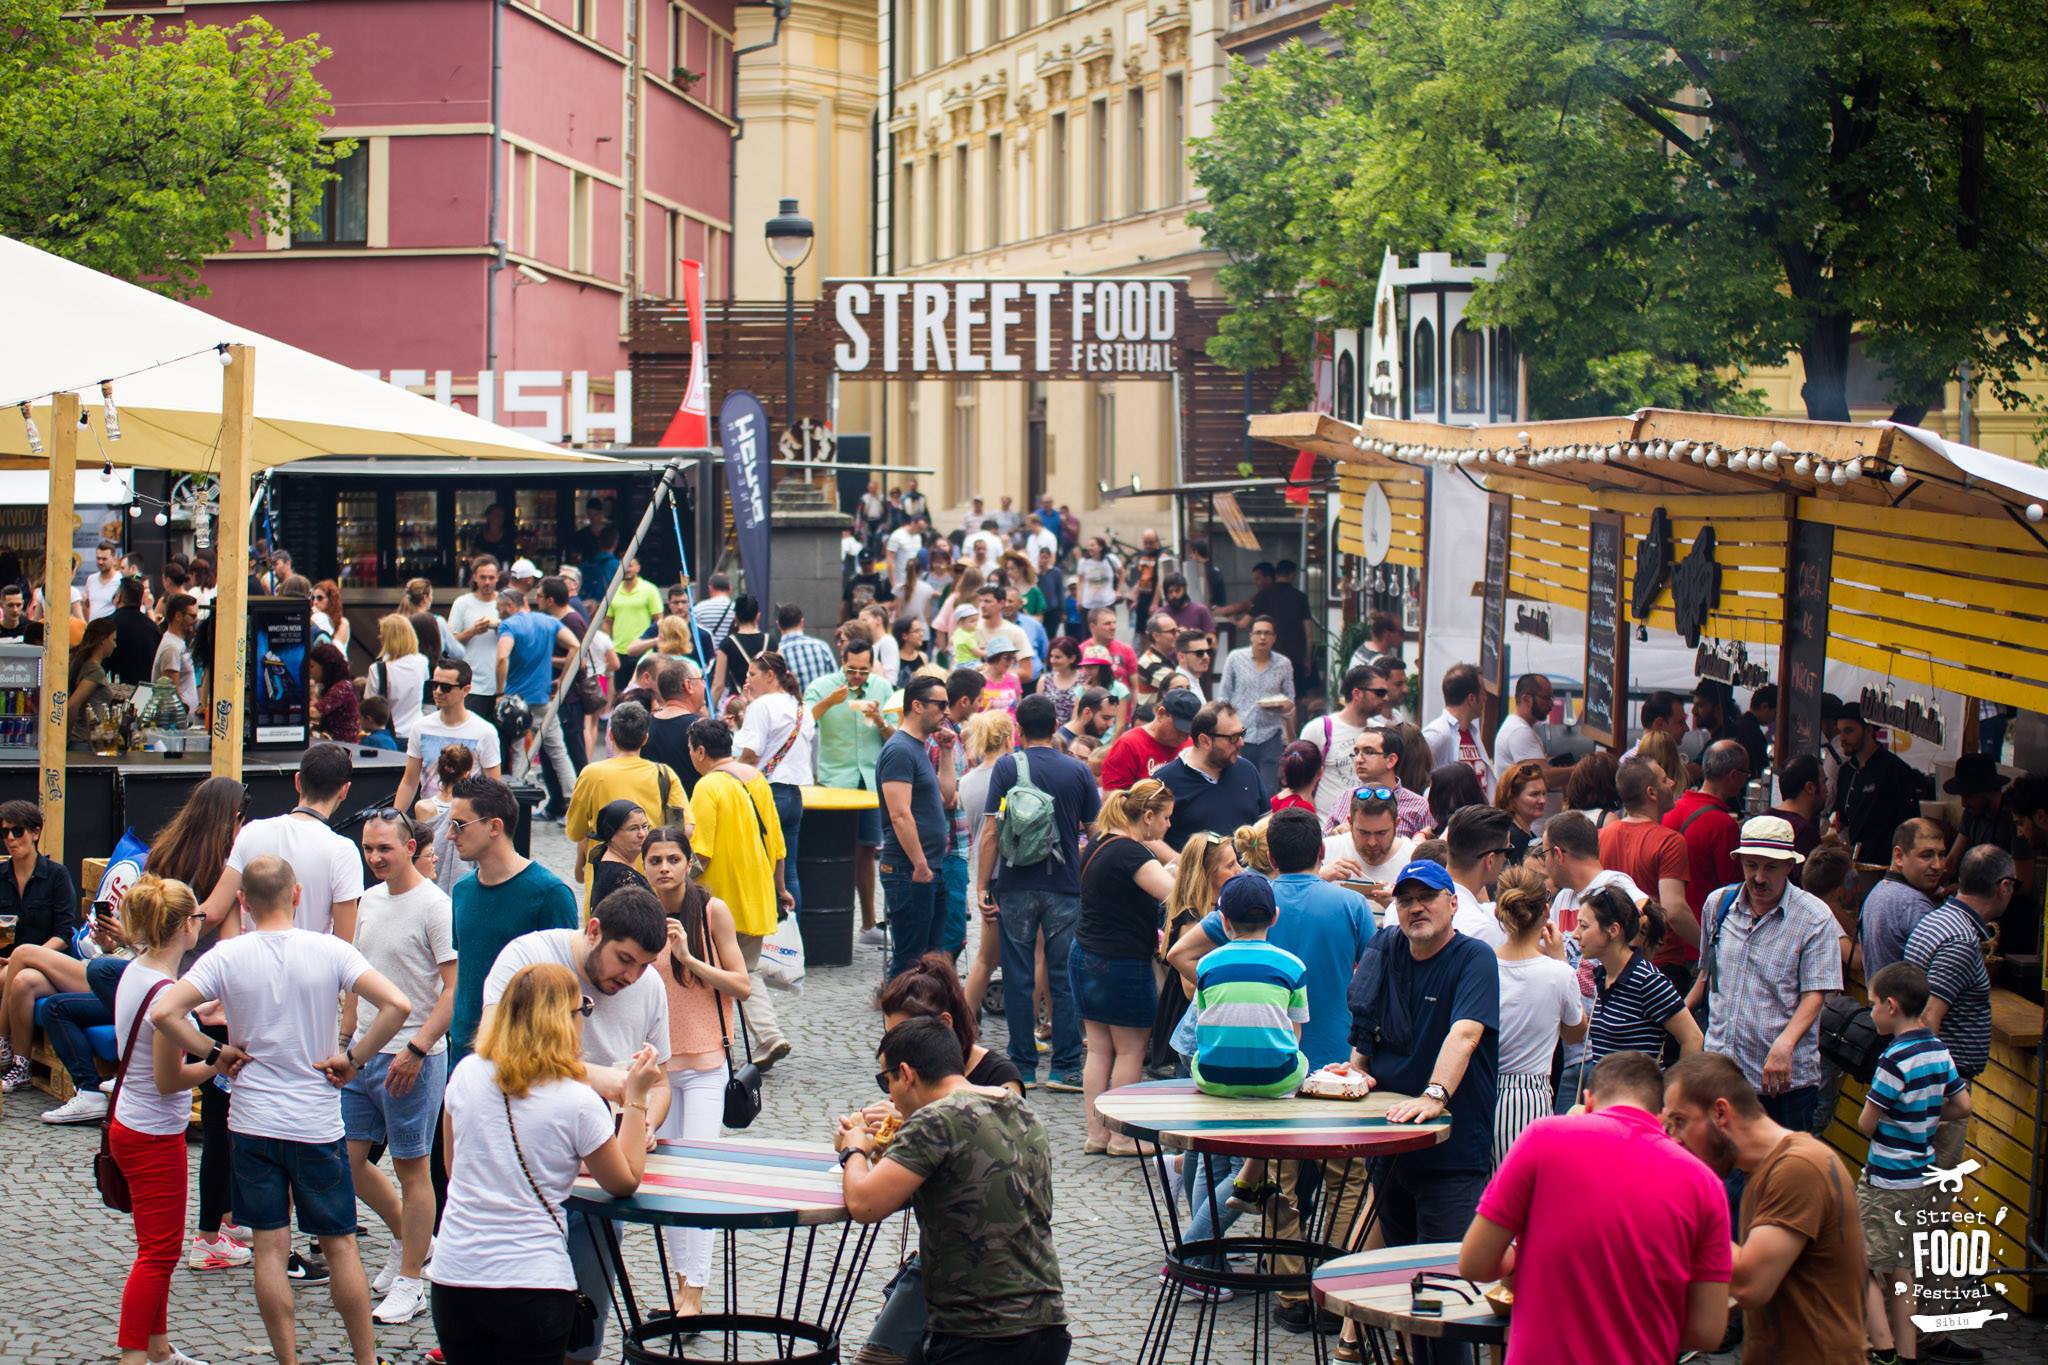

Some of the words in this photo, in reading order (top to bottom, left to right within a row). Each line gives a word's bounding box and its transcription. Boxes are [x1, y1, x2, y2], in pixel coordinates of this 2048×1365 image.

[834, 282, 1061, 372] STREET
[1072, 281, 1176, 341] FOOD
[1071, 343, 1176, 372] FESTIVAL
